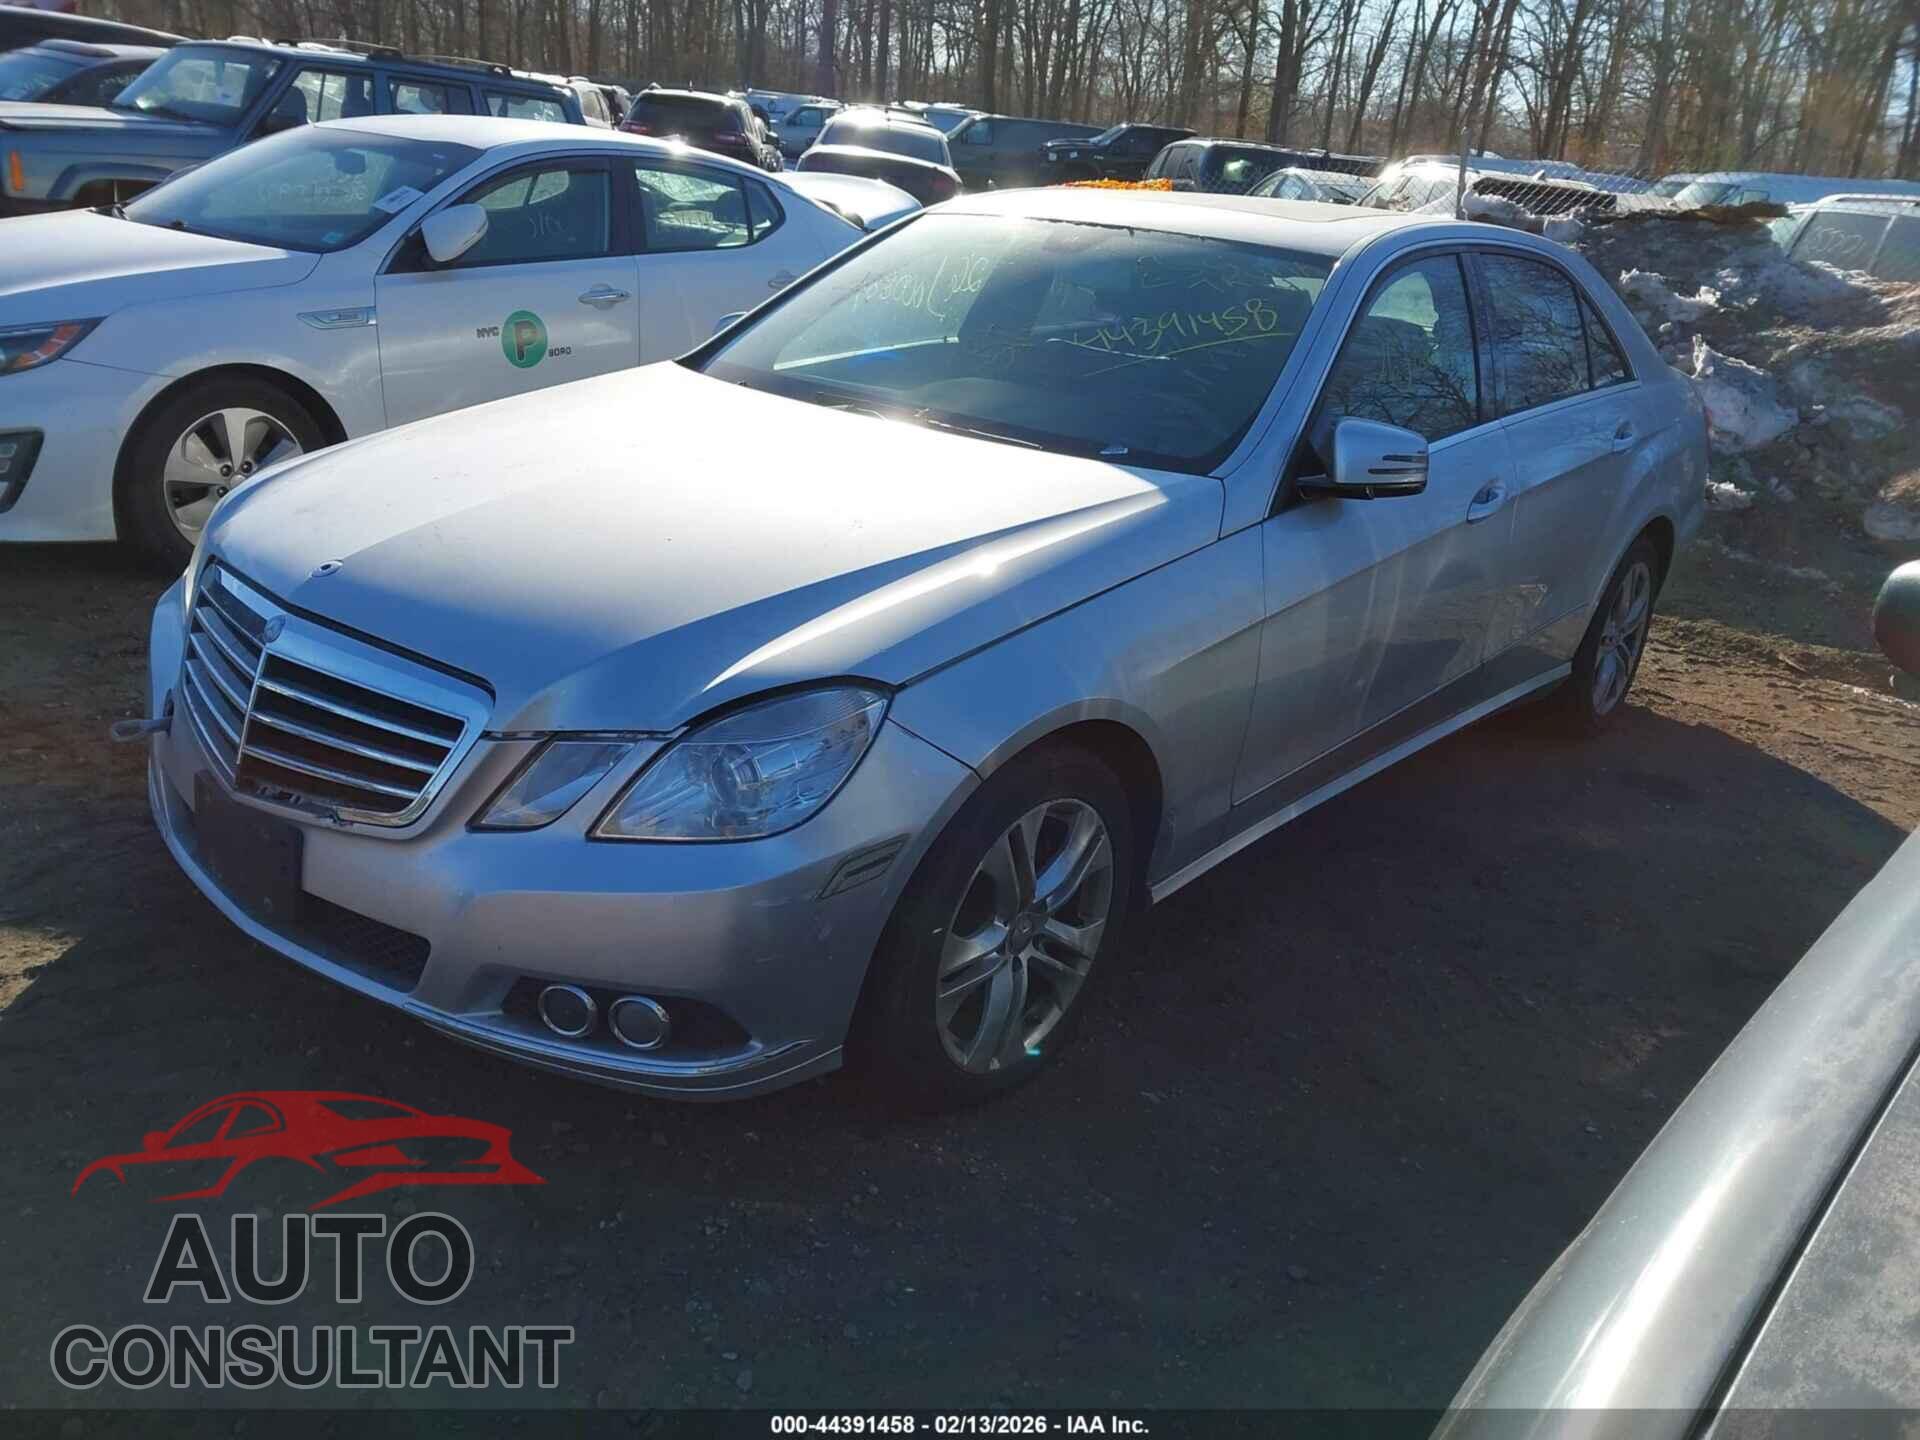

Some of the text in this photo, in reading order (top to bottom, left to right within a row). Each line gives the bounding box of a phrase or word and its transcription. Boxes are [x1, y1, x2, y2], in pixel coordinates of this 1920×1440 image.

[476, 326, 500, 339] NYC
[1072, 297, 1278, 351] 44391458
[513, 319, 538, 361] P
[548, 346, 573, 358] BORO
